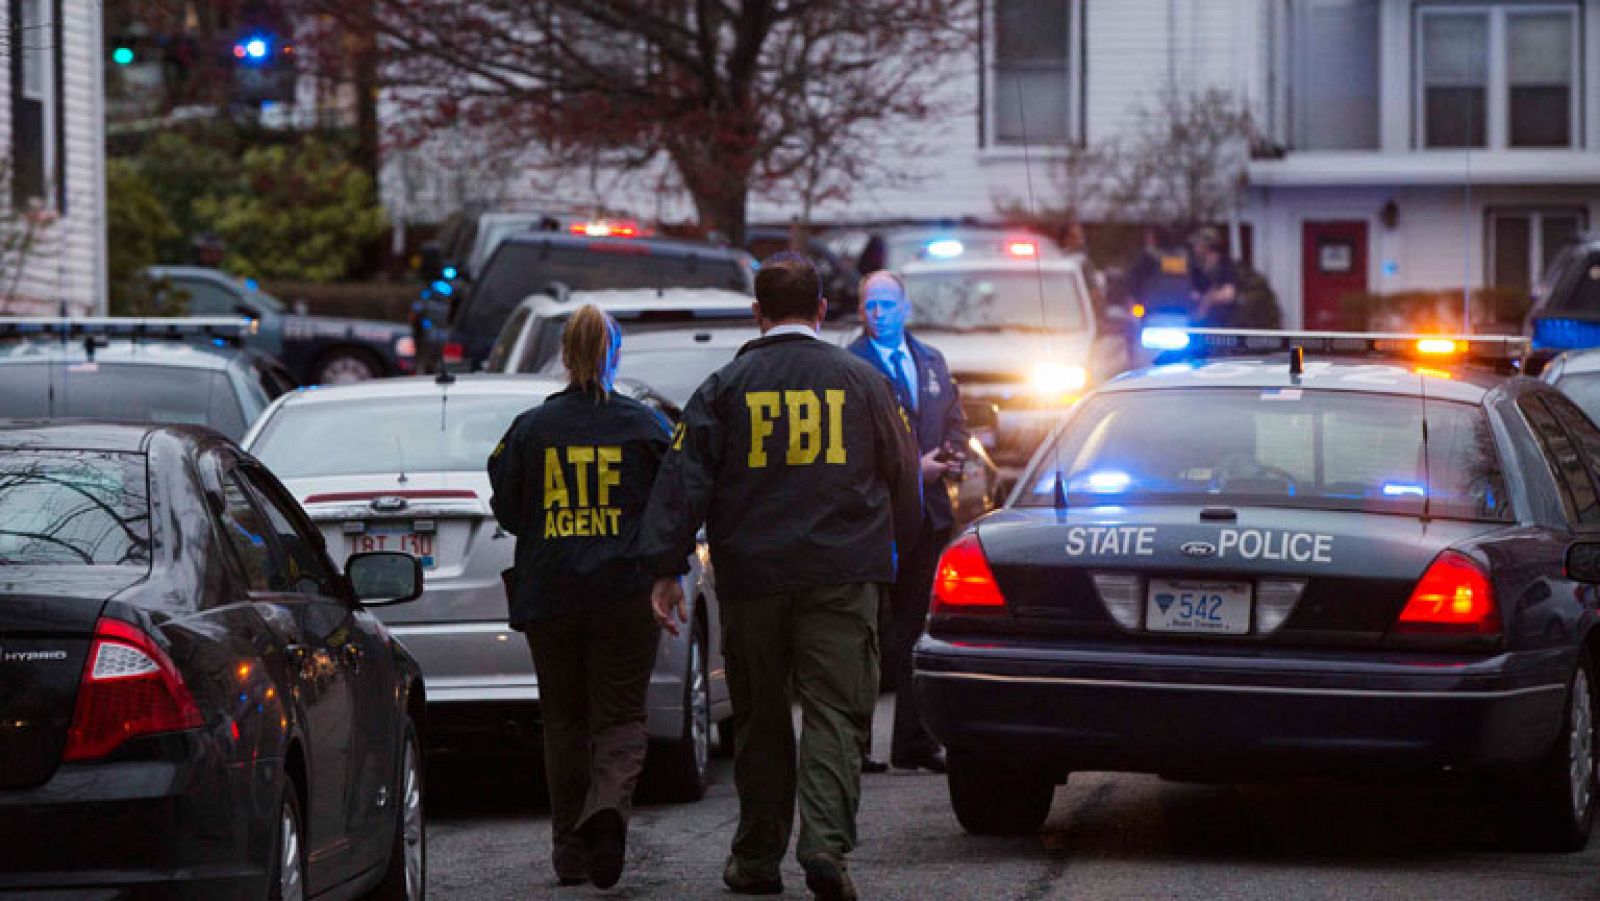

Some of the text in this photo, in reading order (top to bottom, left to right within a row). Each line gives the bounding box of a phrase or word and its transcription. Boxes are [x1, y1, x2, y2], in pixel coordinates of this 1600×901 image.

[745, 389, 847, 468] FBI
[543, 445, 623, 509] ATF
[543, 508, 622, 539] AGENT
[1065, 527, 1334, 563] STATE POLICE
[1180, 593, 1223, 620] 542
[5, 651, 67, 661] HYBRID
